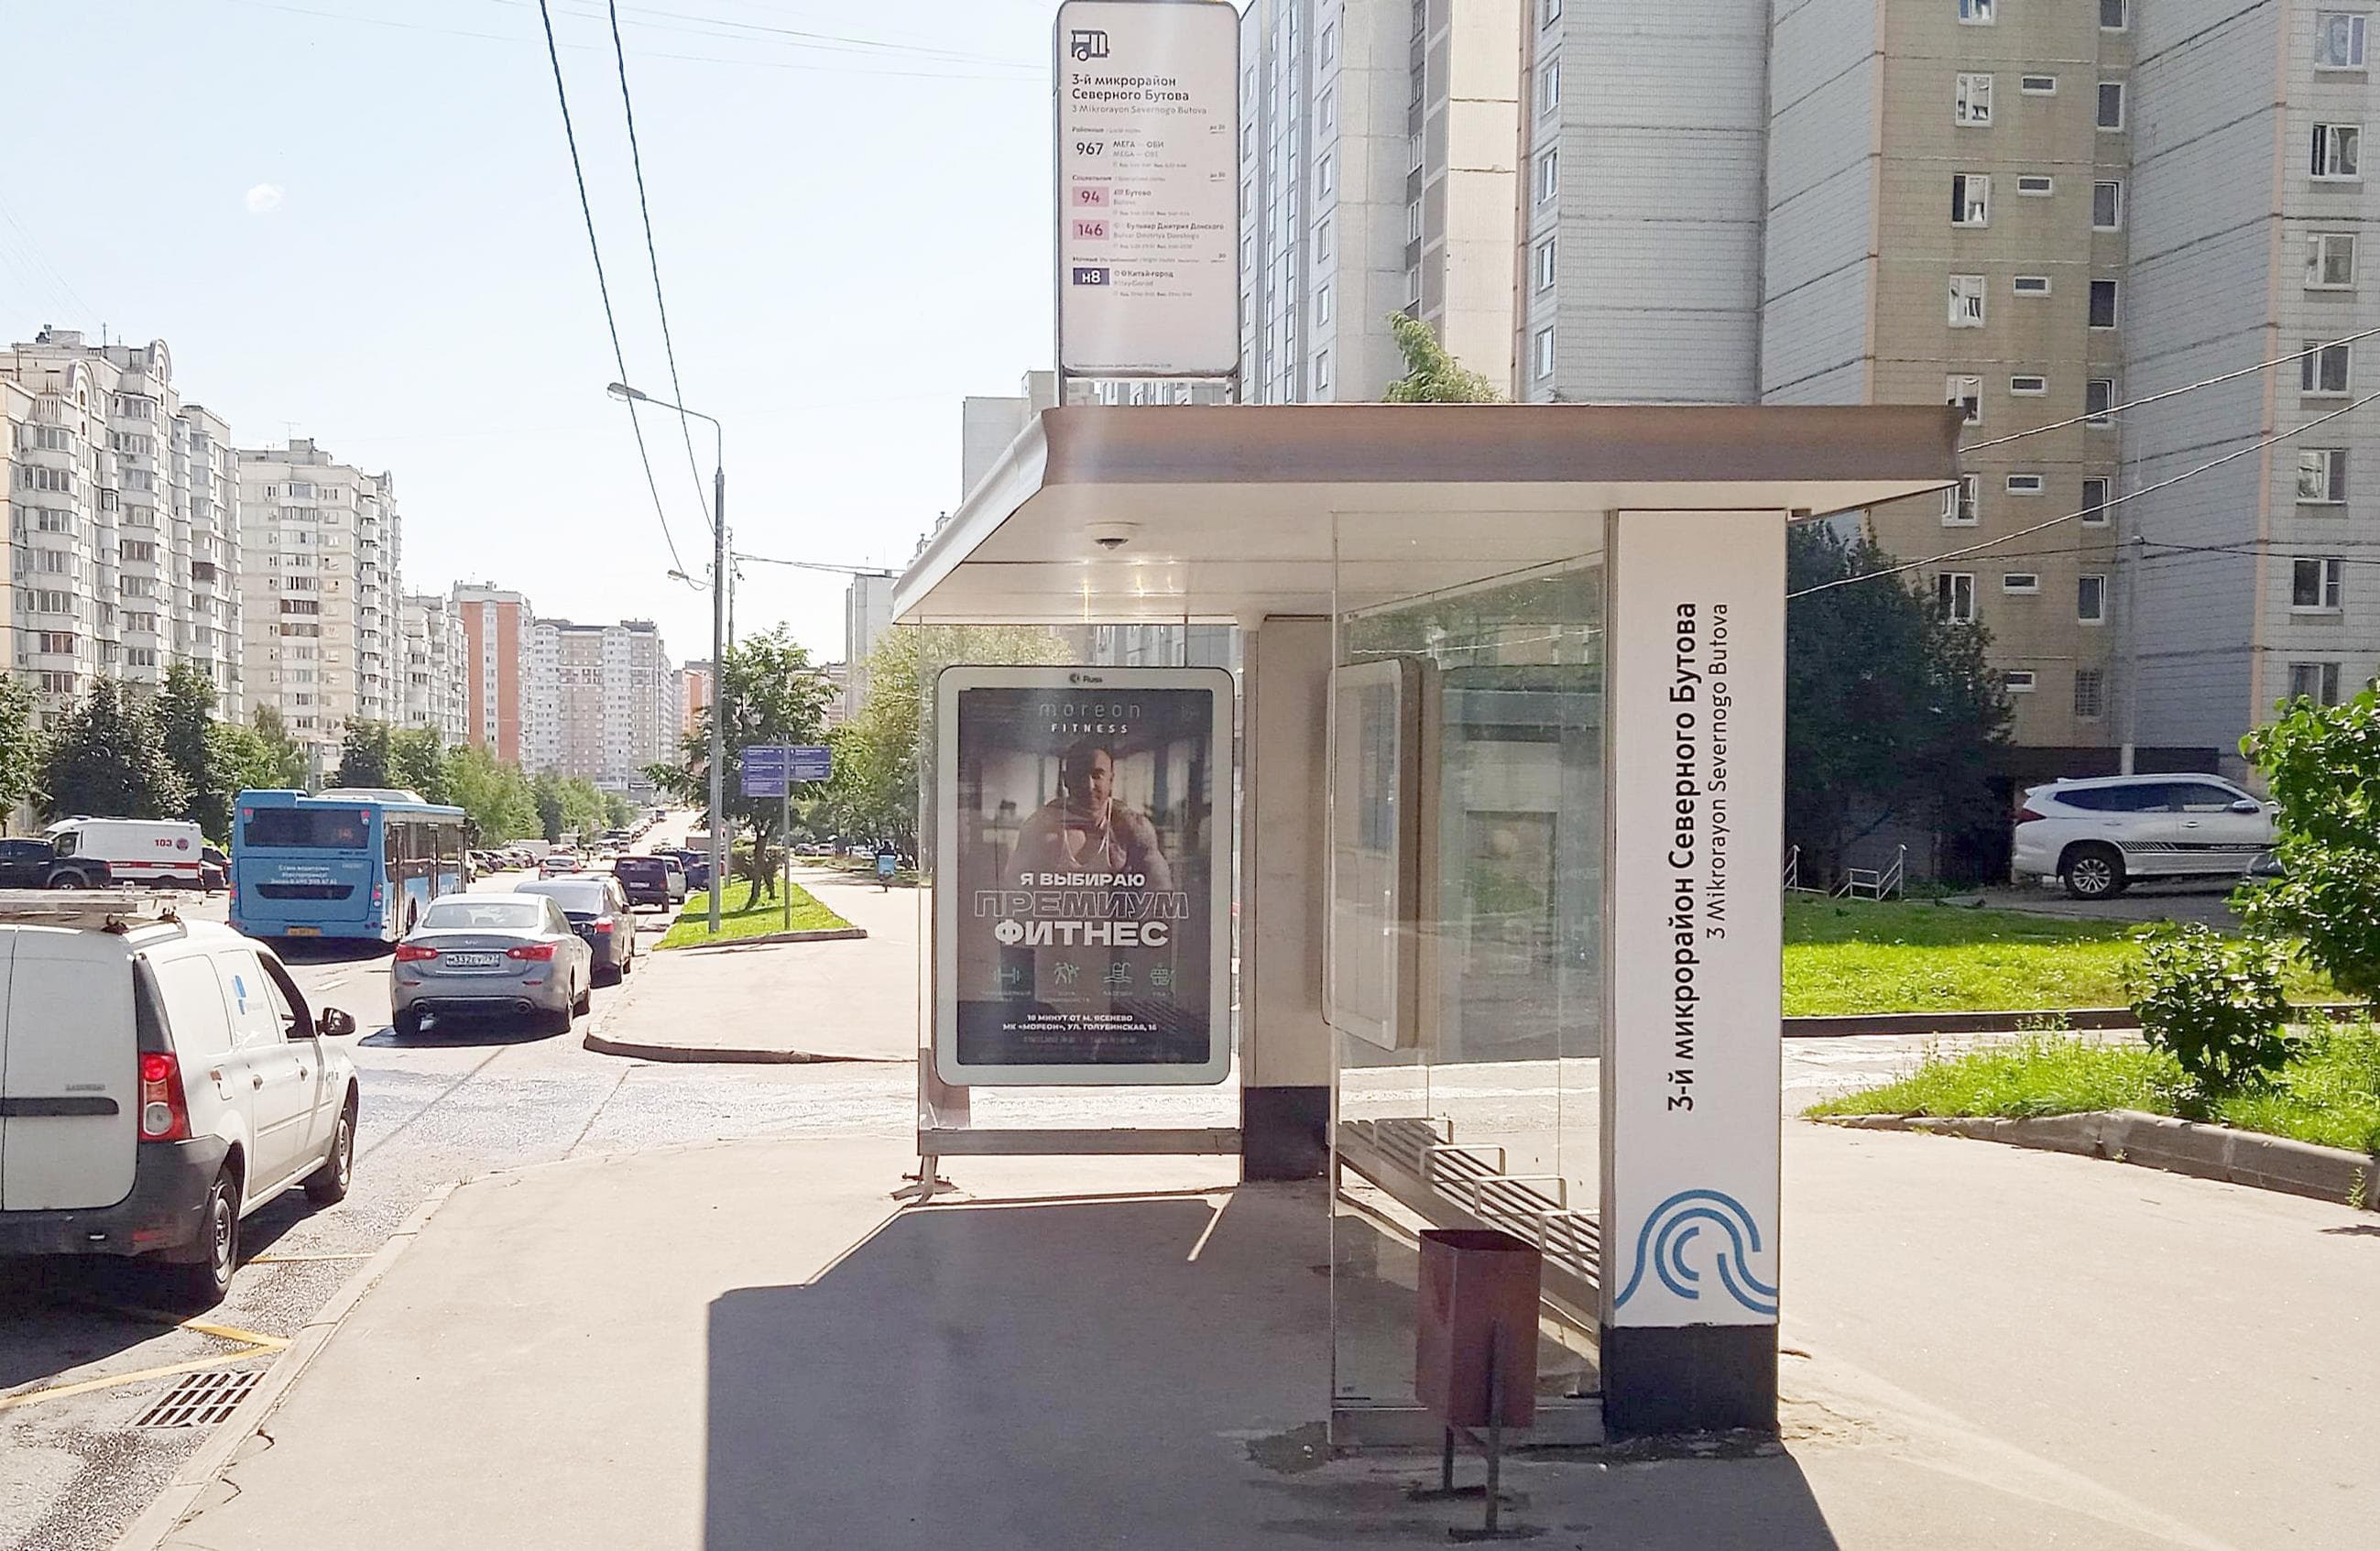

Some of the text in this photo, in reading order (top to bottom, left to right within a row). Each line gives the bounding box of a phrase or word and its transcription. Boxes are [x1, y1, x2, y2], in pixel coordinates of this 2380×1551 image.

[1072, 74, 1176, 88] 3-й микрорайон
[1072, 89, 1189, 103] Северного Бутова
[1079, 105, 1130, 115] Mikrorayon
[1130, 105, 1176, 115] Severnogo
[1076, 142, 1104, 155] 967
[1081, 191, 1100, 203] 94
[1078, 224, 1103, 236] 146
[1040, 704, 1141, 717] moreon
[1051, 724, 1128, 733] FITNESS
[1706, 604, 1731, 939] 3 Mikrorayon Severnogo Butova
[155, 838, 172, 846] 103
[1667, 603, 1701, 1111] 3-й микрорайон Северного Бутова
[1020, 873, 1146, 887] Я ВЫБИРАЮ
[975, 890, 1189, 919] ПРЕМИУМ
[994, 919, 1169, 946] ФИТНЕС
